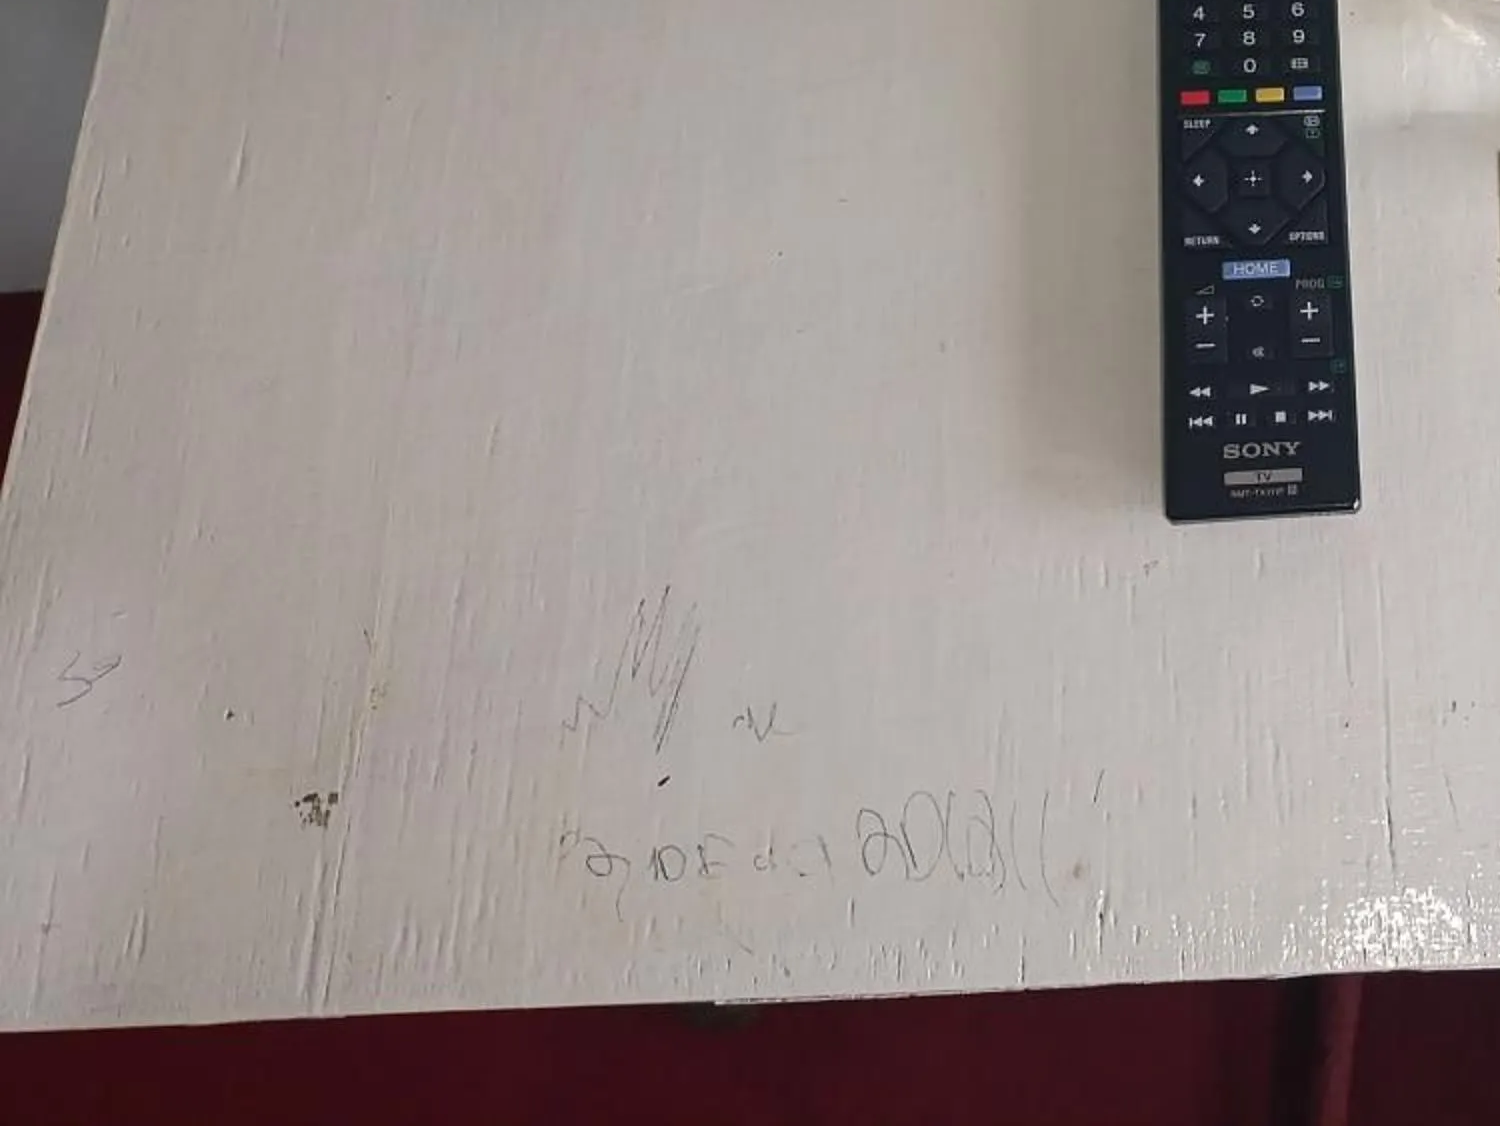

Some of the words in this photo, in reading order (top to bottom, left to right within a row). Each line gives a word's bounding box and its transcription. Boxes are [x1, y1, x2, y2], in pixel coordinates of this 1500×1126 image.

[1193, 6, 1206, 21] 4
[1243, 4, 1255, 19] 5
[1291, 2, 1304, 17] 6
[1194, 32, 1206, 47] 7
[1243, 31, 1255, 46] 8
[1292, 29, 1305, 44] 9
[1243, 58, 1256, 73] 0
[1233, 260, 1279, 275] HOME
[1223, 441, 1300, 460] SONY
